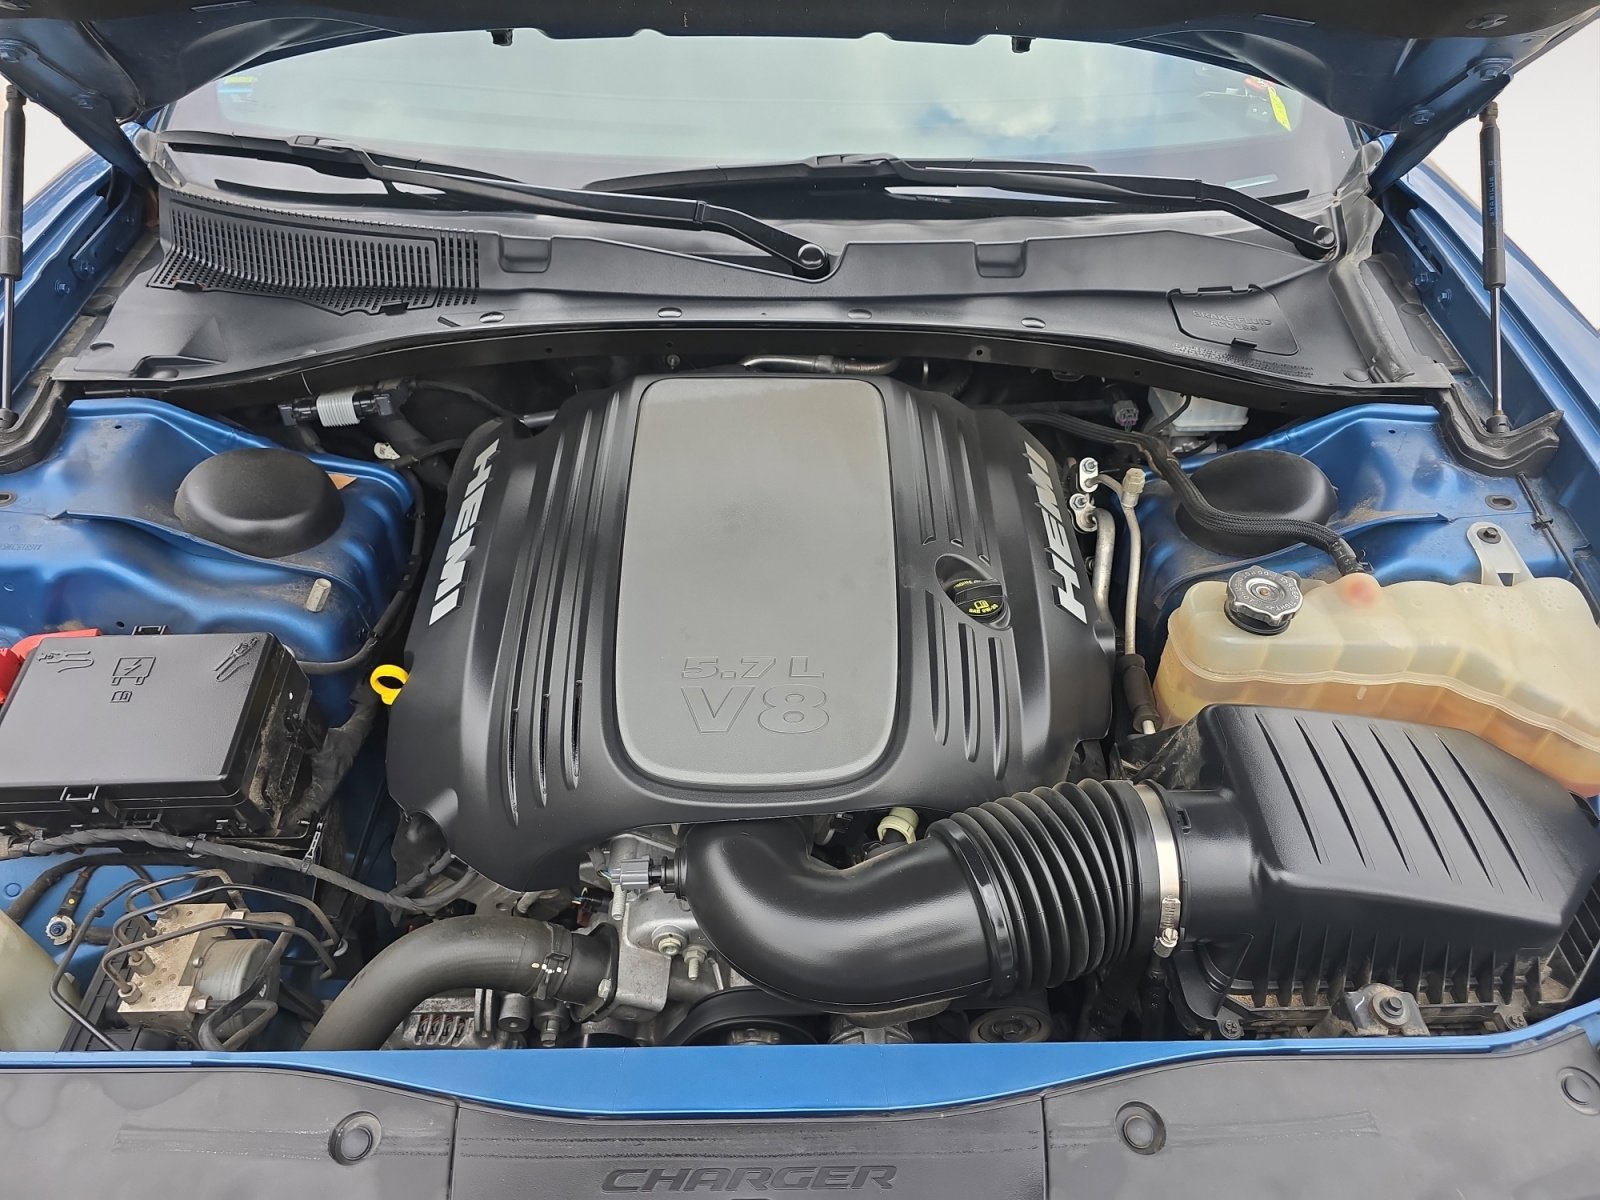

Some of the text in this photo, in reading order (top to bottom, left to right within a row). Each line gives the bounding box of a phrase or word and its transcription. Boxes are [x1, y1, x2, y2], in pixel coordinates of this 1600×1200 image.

[1191, 310, 1273, 326] BRAKE FLUID
[429, 438, 500, 626] HEMI
[1022, 441, 1088, 625] HEMI
[680, 684, 830, 735] V8
[600, 1165, 898, 1193] CHARGER
